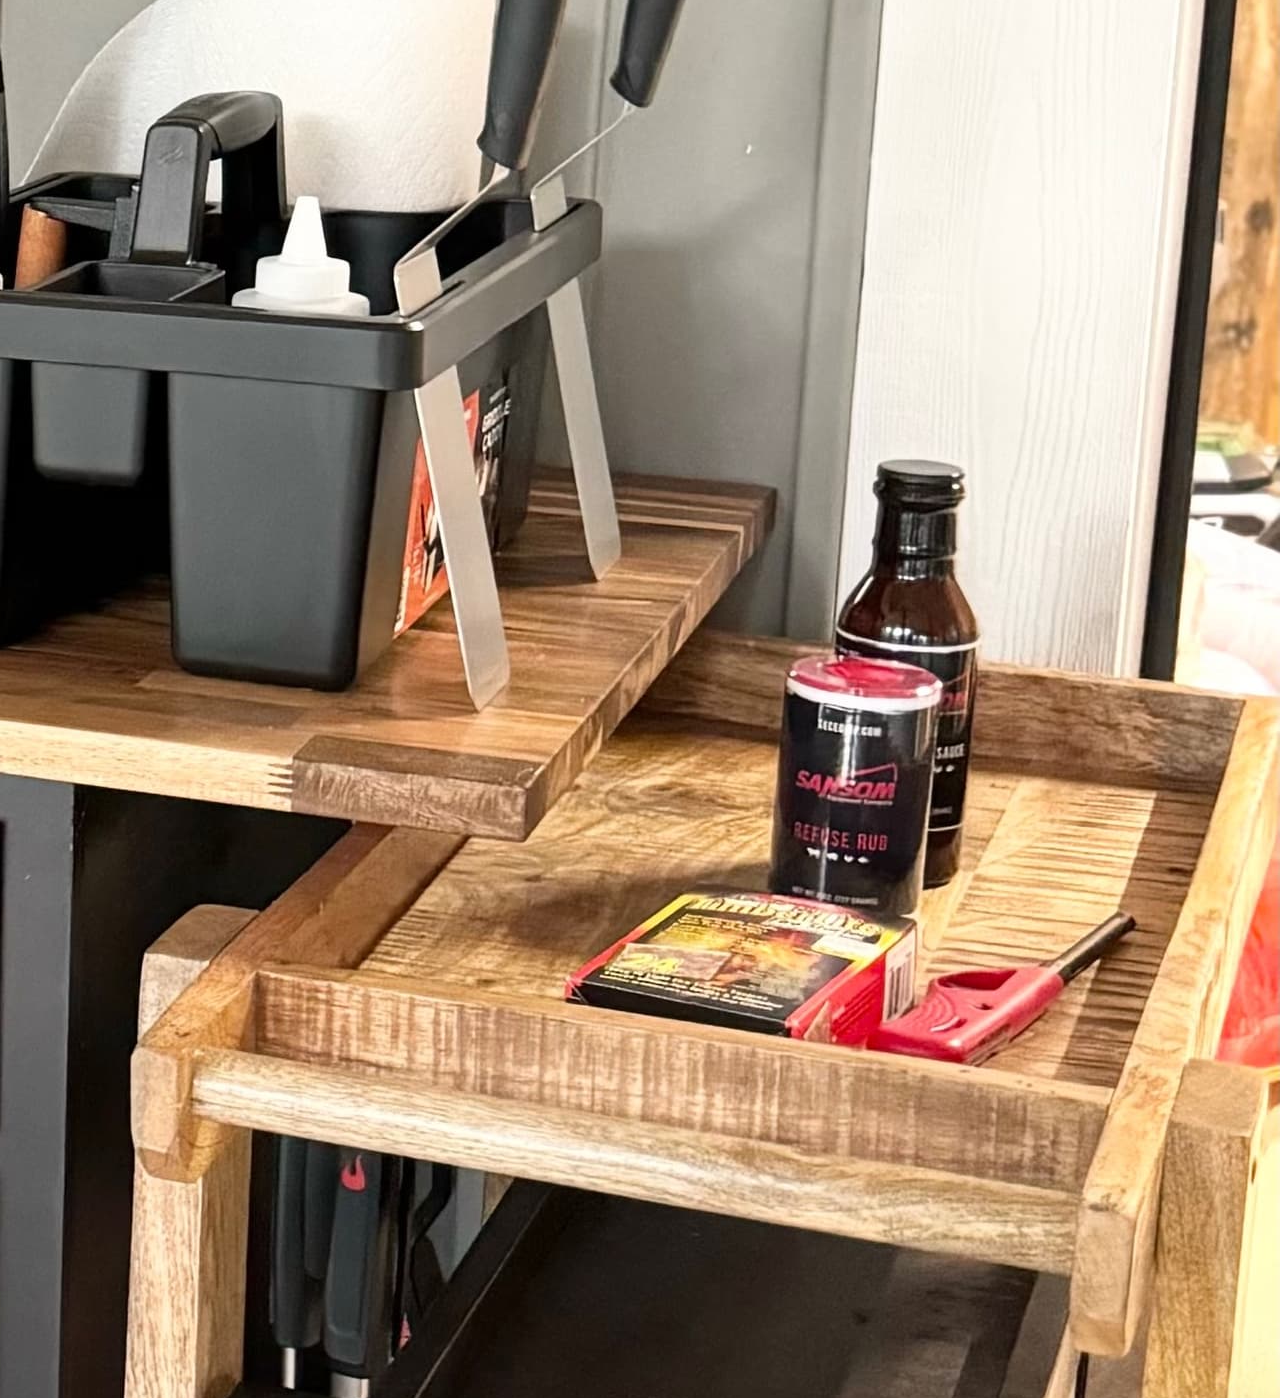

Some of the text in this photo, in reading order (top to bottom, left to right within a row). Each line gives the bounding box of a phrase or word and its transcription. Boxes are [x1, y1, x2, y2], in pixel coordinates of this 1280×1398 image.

[936, 743, 965, 760] SAUCE
[795, 770, 897, 800] SANSOM
[793, 821, 888, 852] REFUSE RUB
